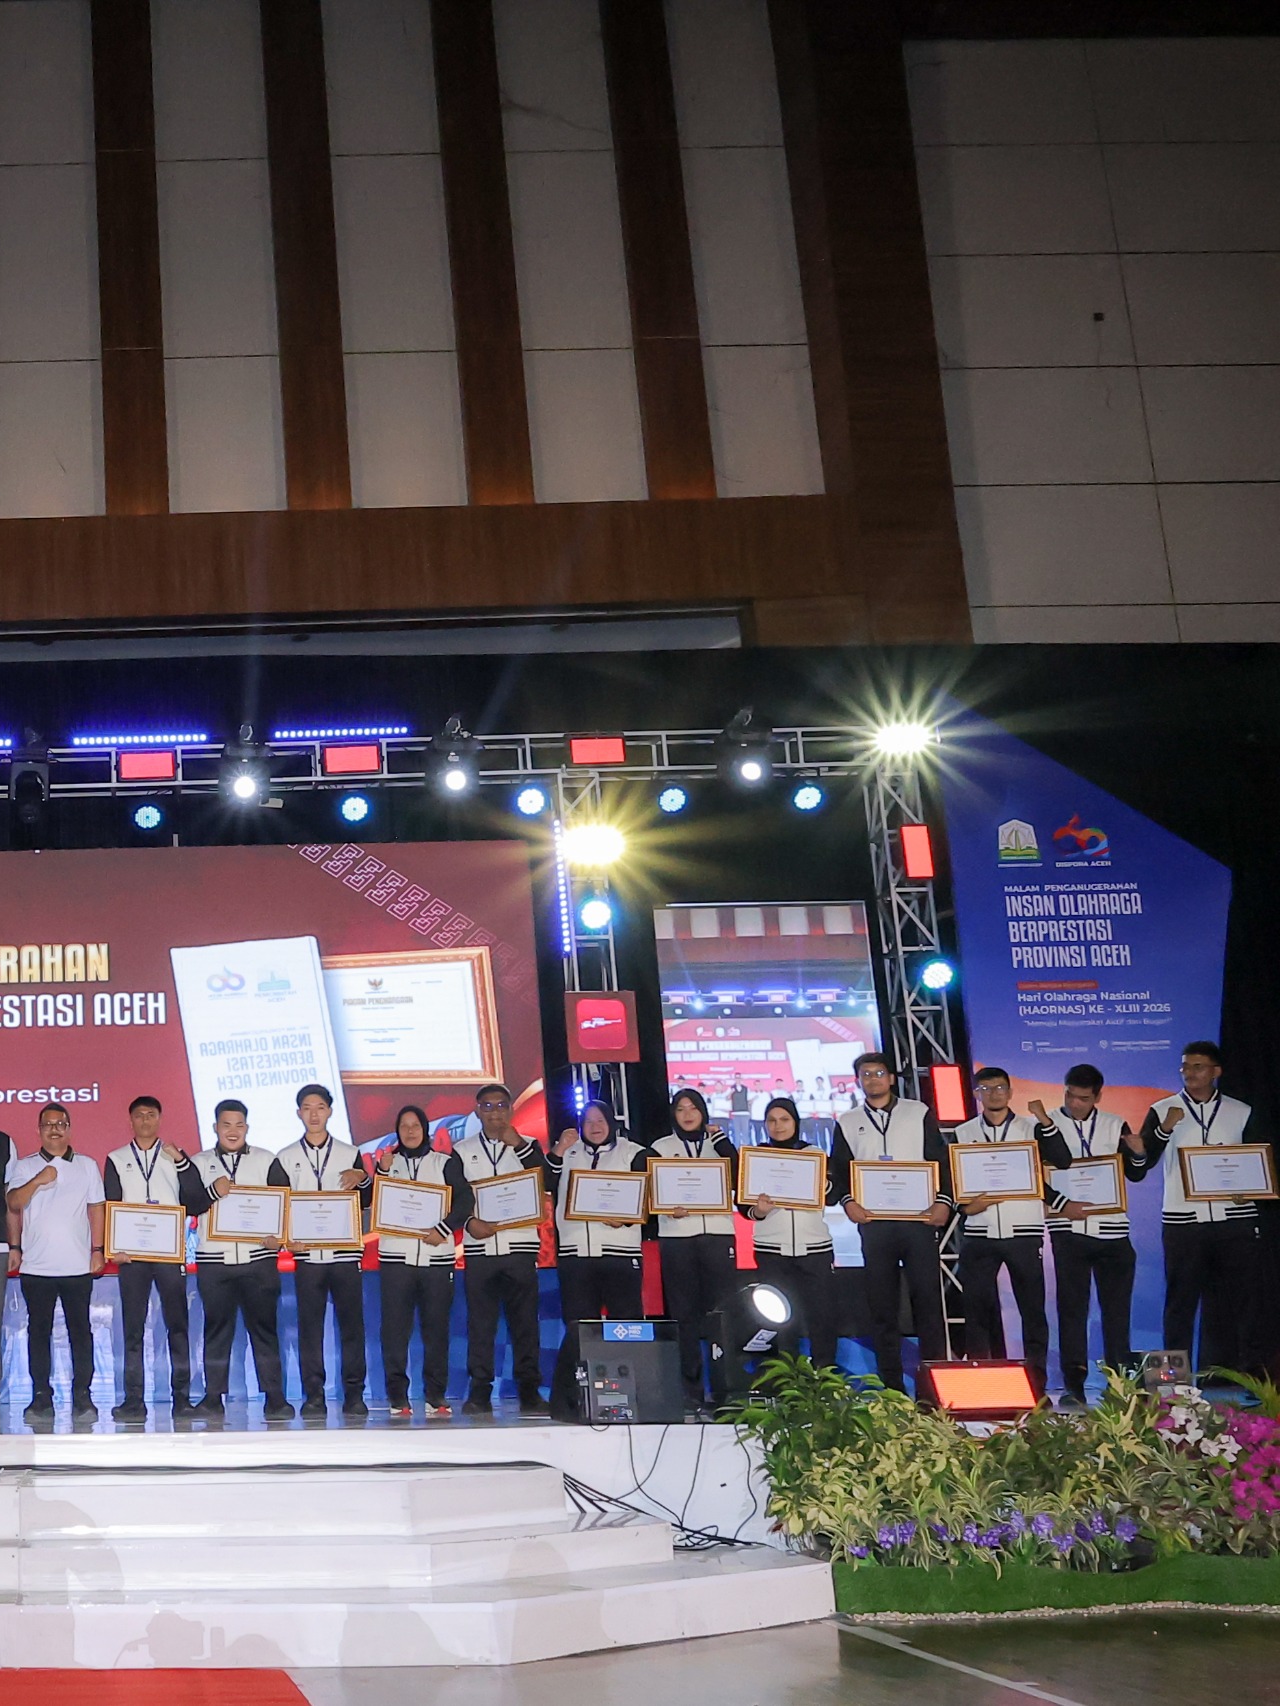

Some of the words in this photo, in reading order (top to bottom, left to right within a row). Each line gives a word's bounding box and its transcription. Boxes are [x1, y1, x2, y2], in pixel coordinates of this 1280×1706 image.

[1004, 885, 1040, 893] MALAM
[1044, 882, 1138, 892] PENGANUGERAHAN
[1005, 895, 1056, 917] INSAN
[1059, 892, 1142, 916] OLAHRAGA
[1008, 919, 1113, 943] BERPRESTASI
[1011, 946, 1087, 969] PROVINSI
[1091, 945, 1131, 967] ACEH
[93, 992, 166, 1025] ACEH
[1018, 992, 1041, 1002] Hari
[1044, 992, 1097, 1003] Olahraga
[1100, 990, 1150, 1000] Nasional
[1019, 1005, 1086, 1016] (HAORNAS)
[1089, 1005, 1104, 1014] KE
[1115, 1004, 1140, 1013] XLIII
